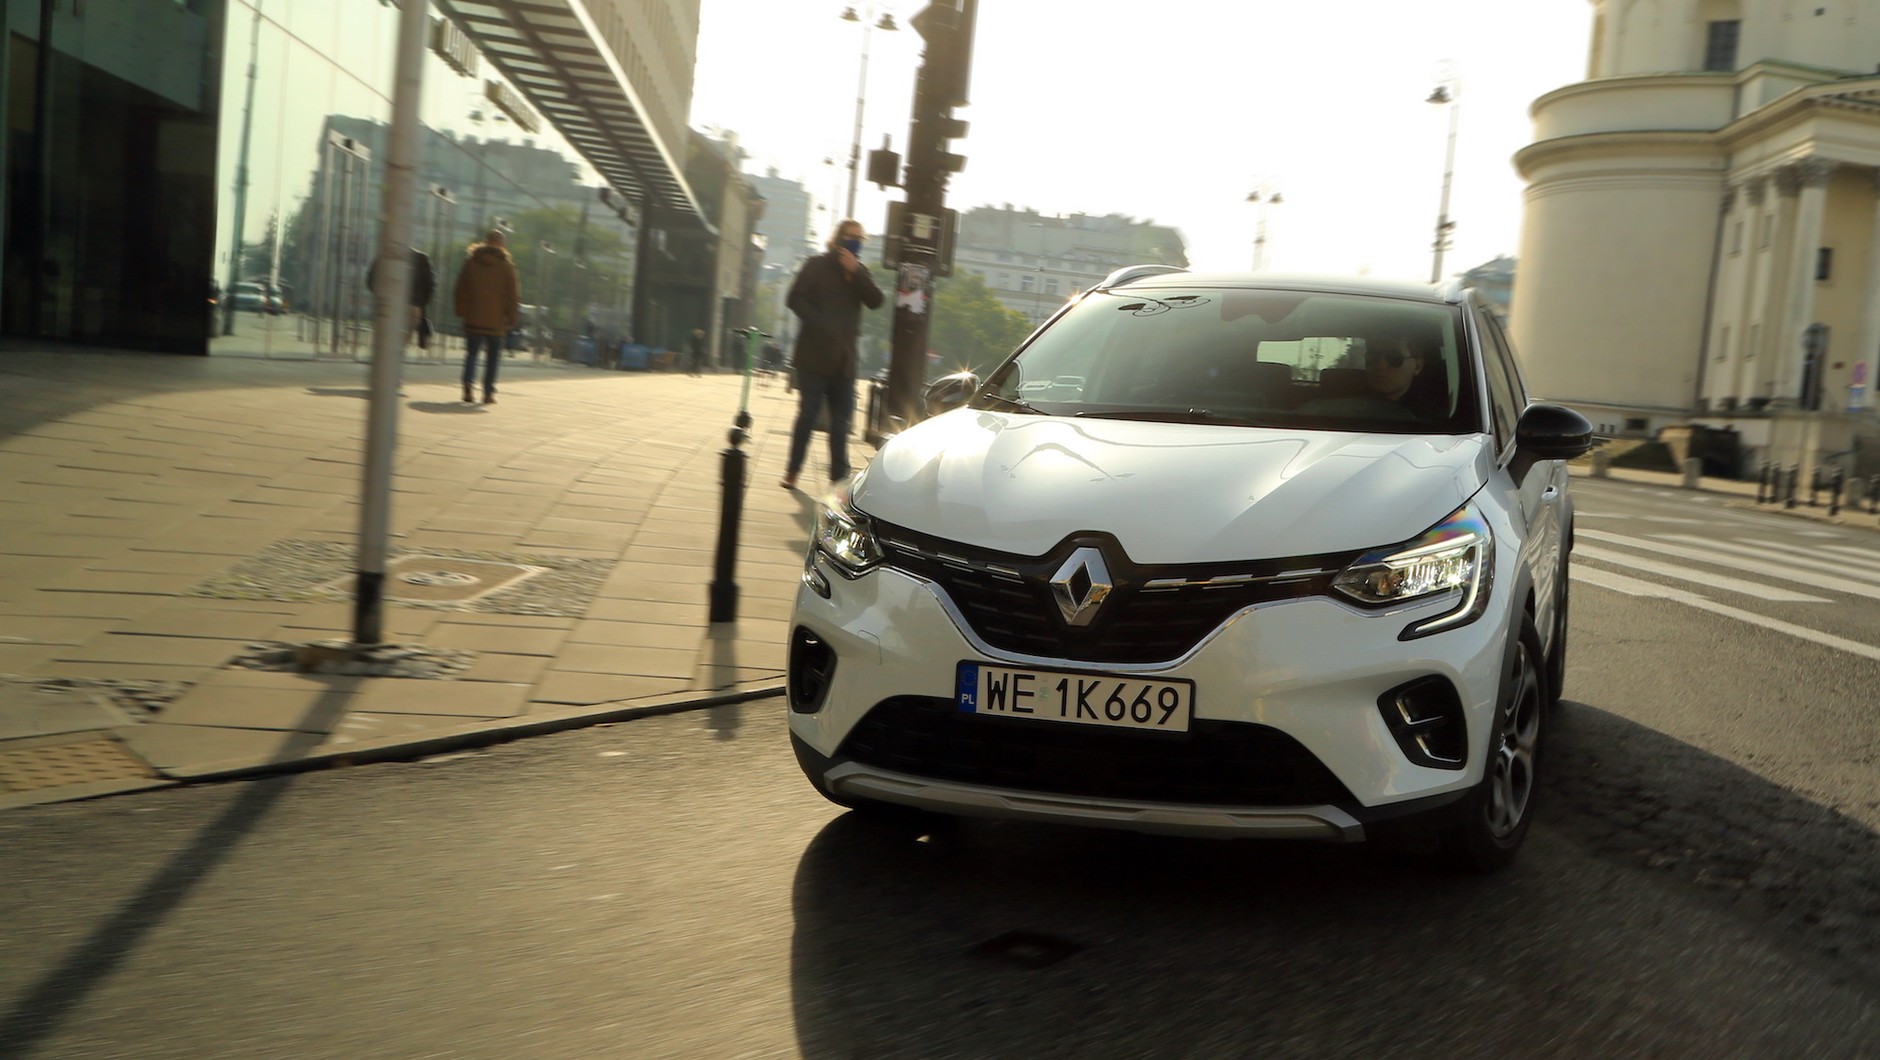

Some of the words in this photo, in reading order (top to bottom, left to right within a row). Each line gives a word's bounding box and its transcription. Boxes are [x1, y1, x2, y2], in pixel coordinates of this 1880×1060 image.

[961, 693, 975, 705] PL
[987, 671, 1036, 714] WE
[1055, 678, 1179, 725] 1K669
